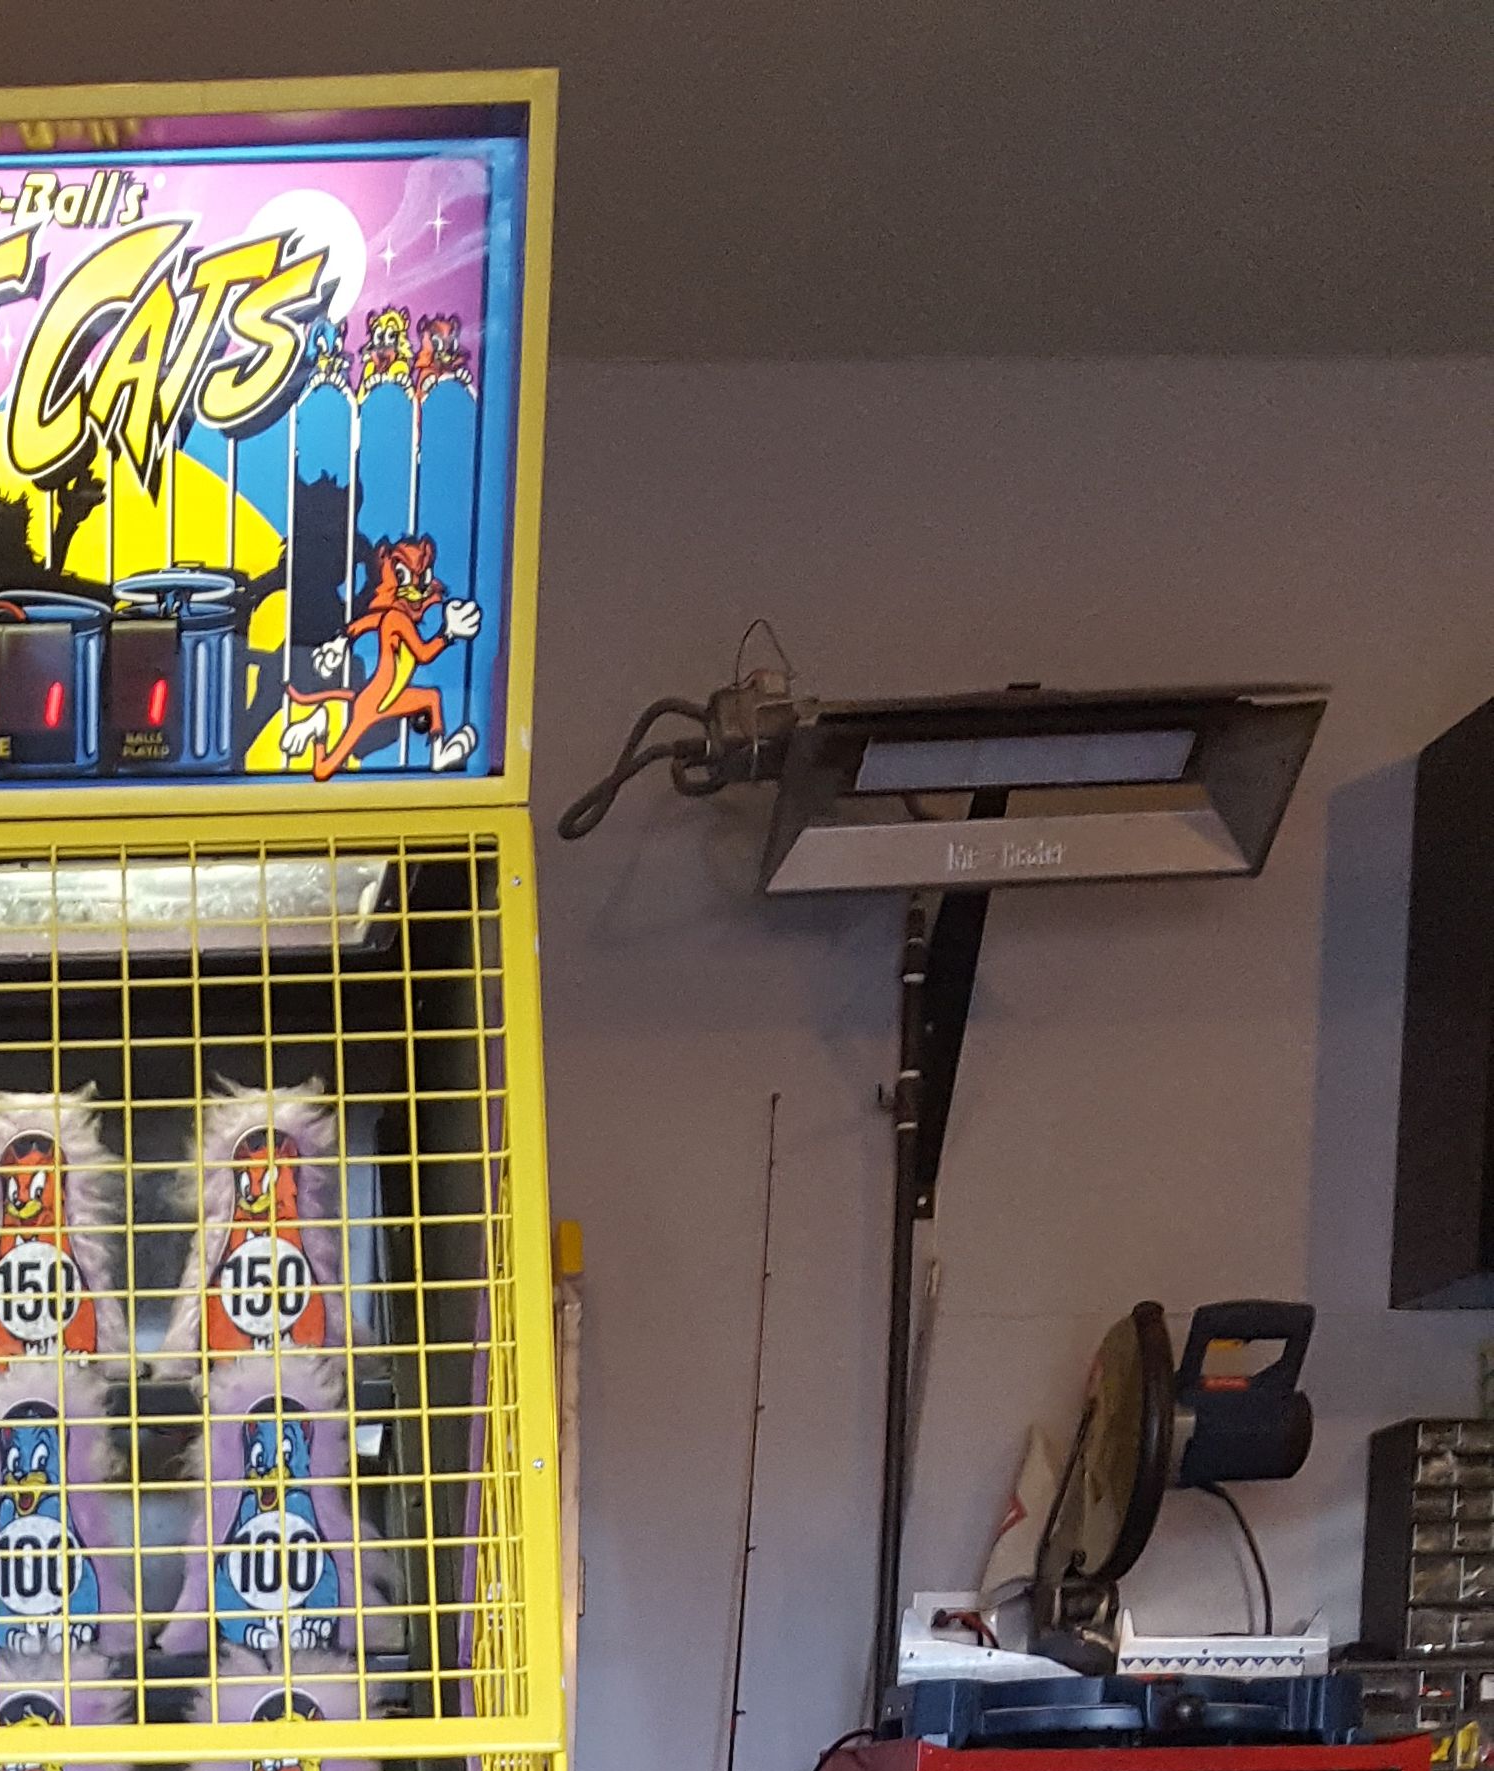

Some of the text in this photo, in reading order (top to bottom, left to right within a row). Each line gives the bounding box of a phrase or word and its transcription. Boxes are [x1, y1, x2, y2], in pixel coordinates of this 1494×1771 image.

[8, 220, 332, 484] CATS
[122, 744, 170, 757] PLAYED
[125, 732, 163, 743] BALLS
[223, 1257, 305, 1317] 150
[234, 1531, 318, 1593] 100
